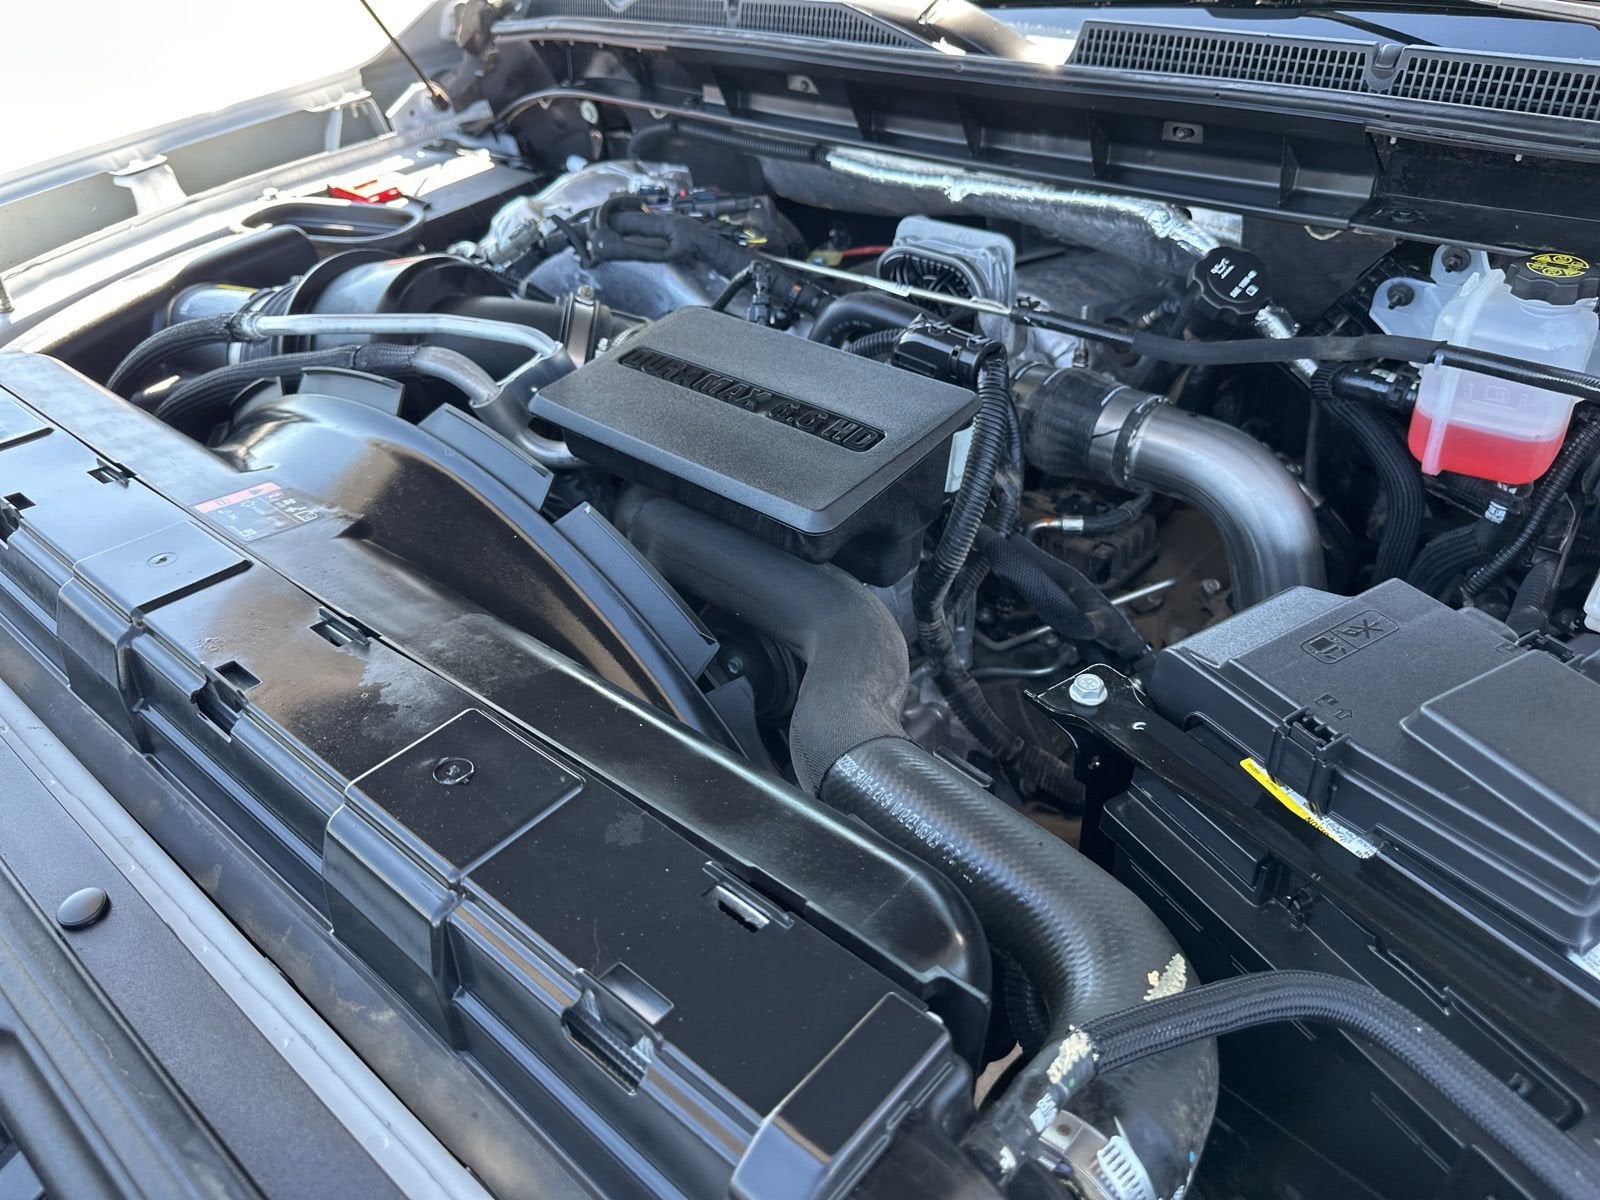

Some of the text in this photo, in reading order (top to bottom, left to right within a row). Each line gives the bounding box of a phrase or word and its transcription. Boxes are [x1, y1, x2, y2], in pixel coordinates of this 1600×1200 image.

[620, 349, 880, 448] DURAMAX 6.6 HD
